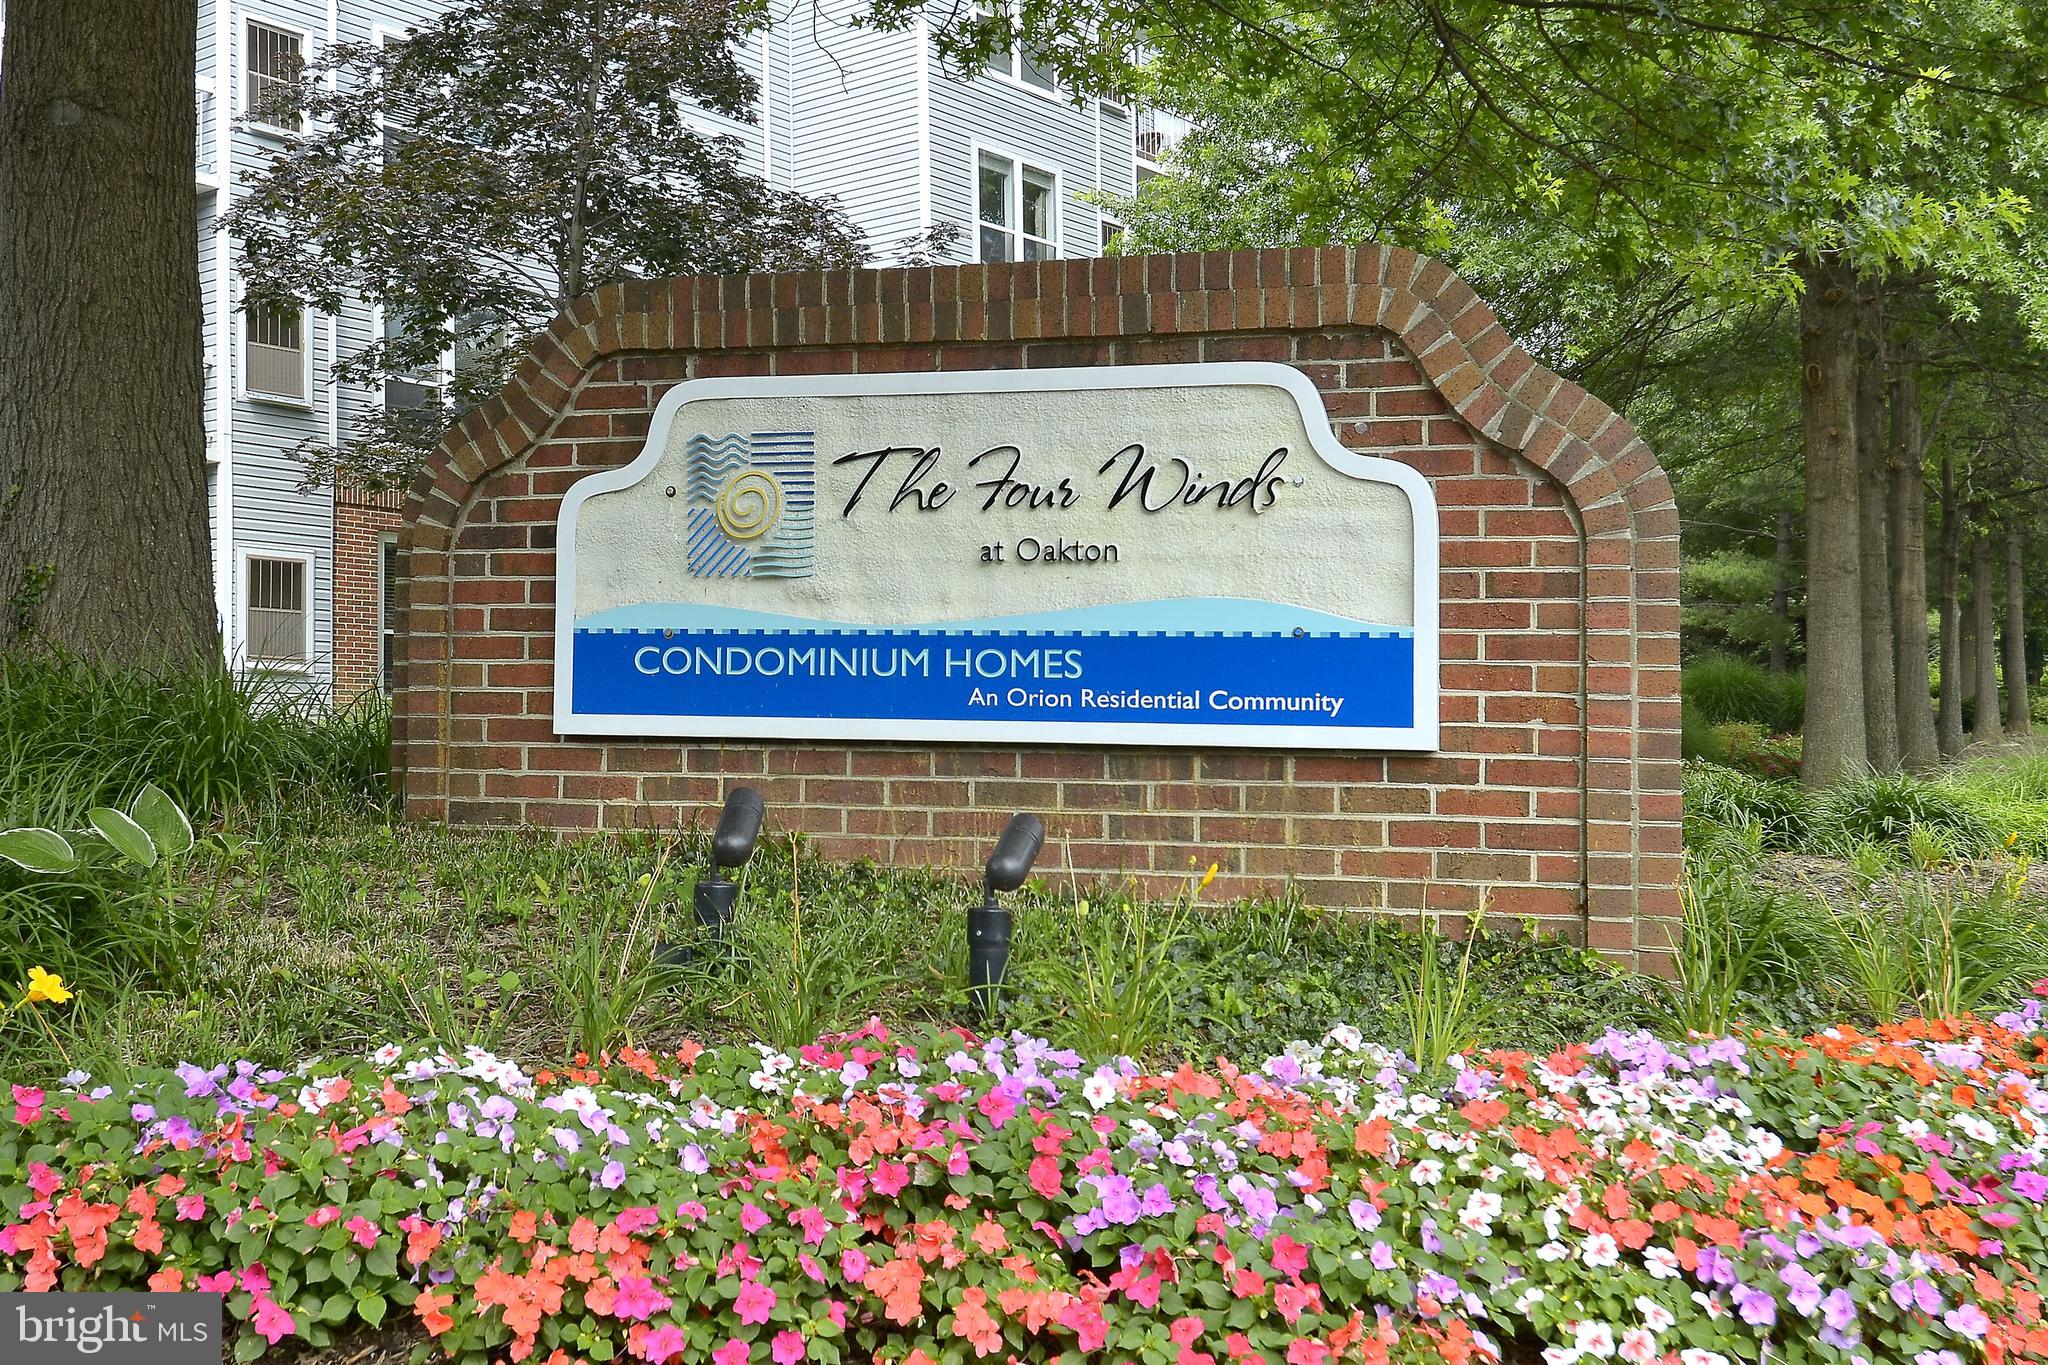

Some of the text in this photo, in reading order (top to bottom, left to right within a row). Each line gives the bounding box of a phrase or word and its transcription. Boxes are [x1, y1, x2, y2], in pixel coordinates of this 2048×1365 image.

[832, 443, 1289, 517] The Four Winds
[980, 537, 1120, 563] at Oakton
[633, 646, 1084, 680] CONDOMINIUM HOMES
[967, 687, 1345, 718] An Orion Residential Community
